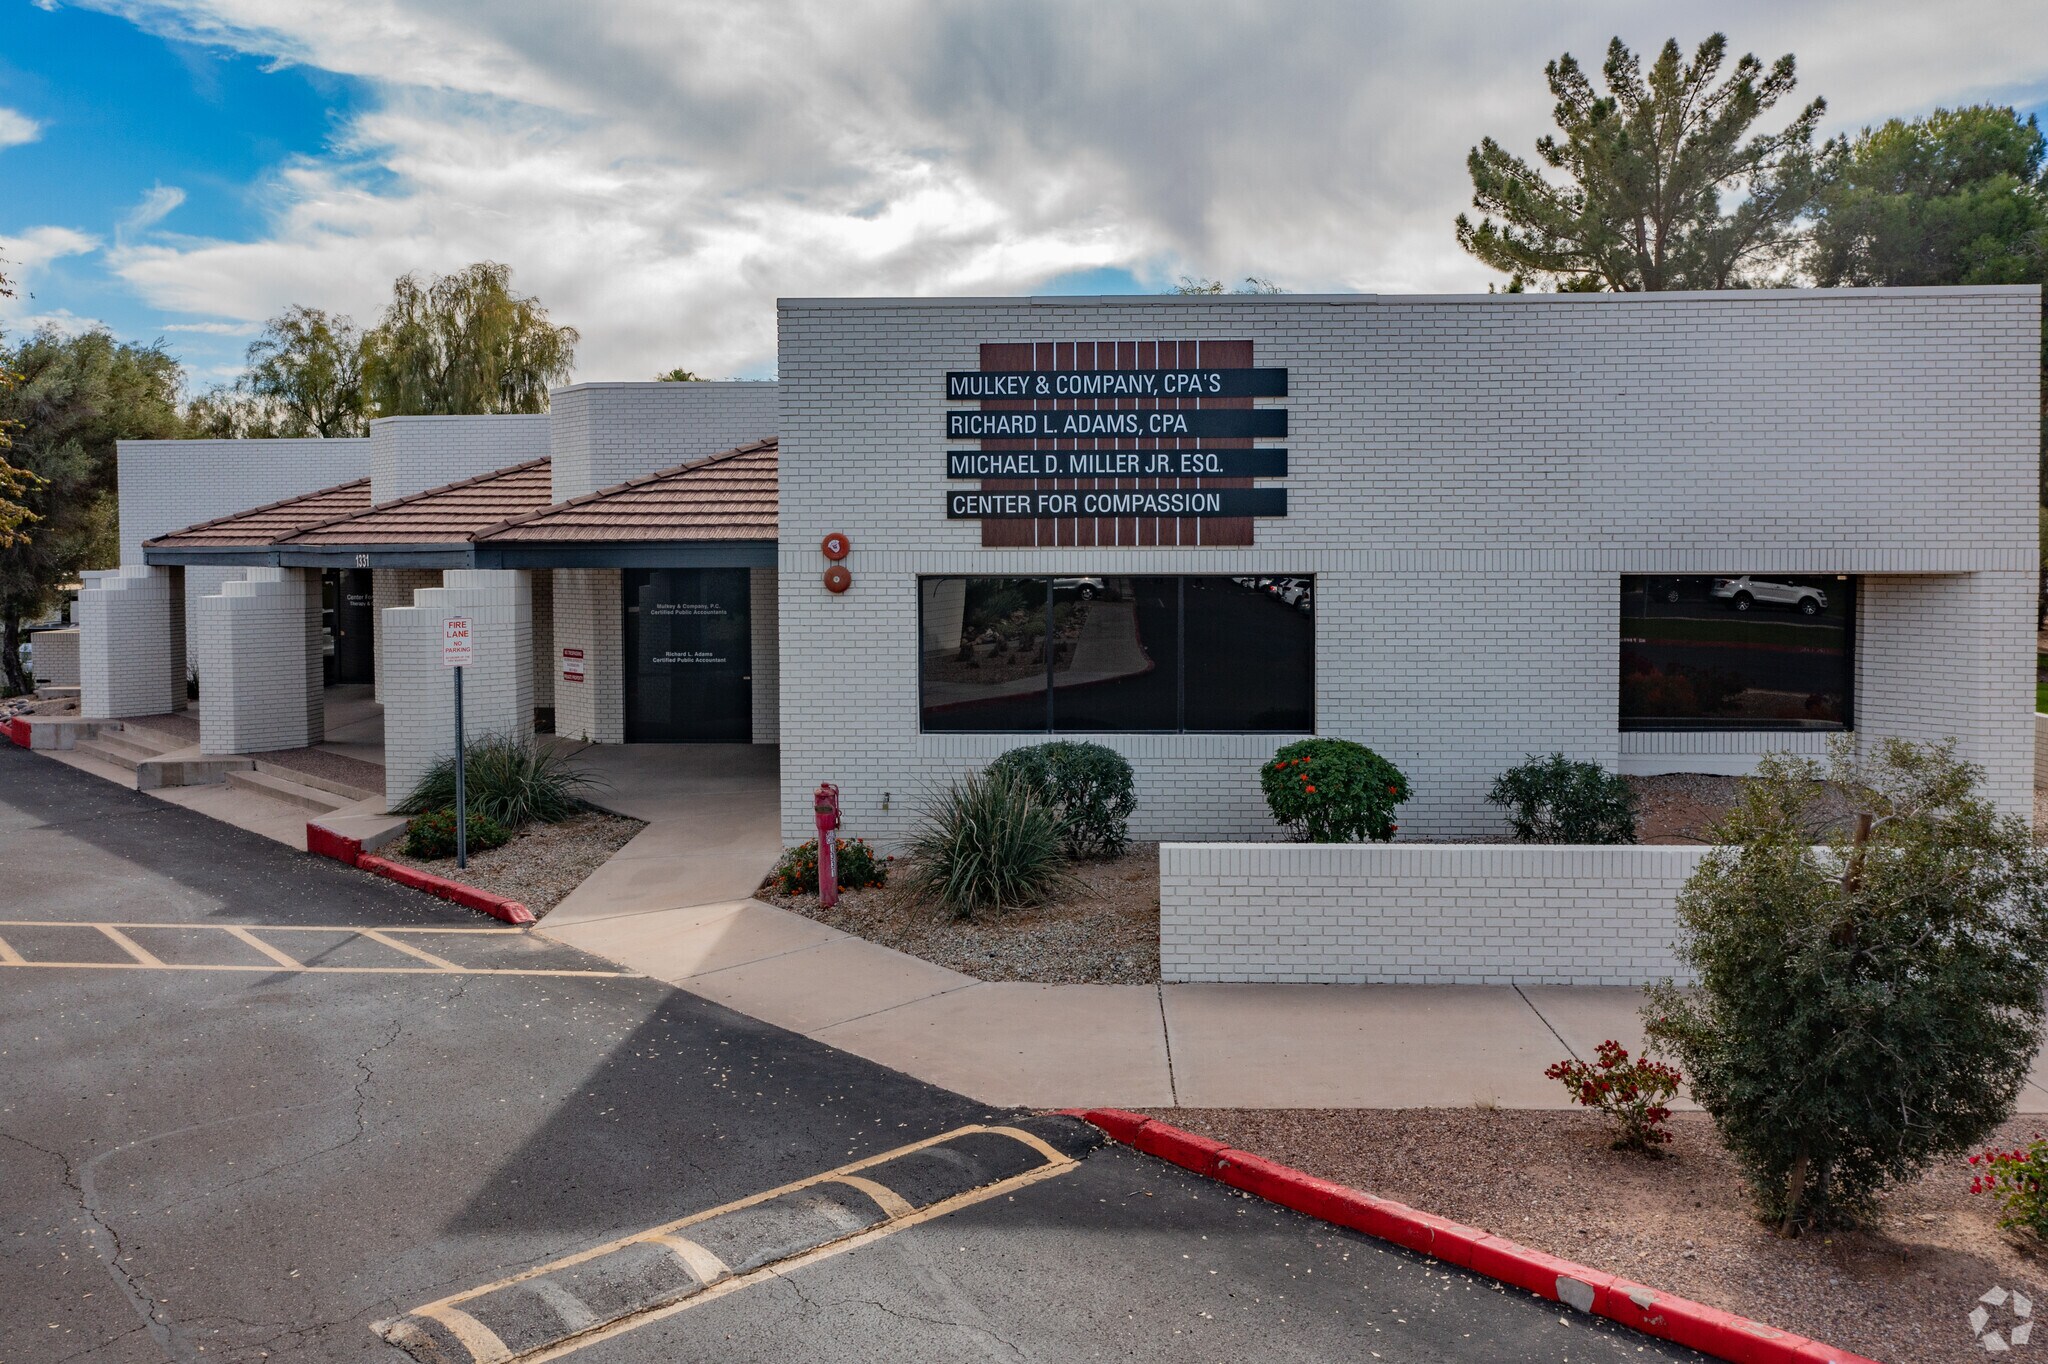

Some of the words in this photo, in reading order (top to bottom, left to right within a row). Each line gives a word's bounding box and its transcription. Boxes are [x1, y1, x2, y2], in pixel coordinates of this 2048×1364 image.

[951, 375, 1030, 395] MULKEY
[1035, 375, 1050, 394] &
[1056, 374, 1158, 396] COMPANY,
[1164, 373, 1221, 394] CPA'S
[951, 415, 1037, 434] RICHARD
[1043, 414, 1058, 433] L.
[1063, 414, 1143, 436] ADAMS,
[1149, 414, 1188, 433] CPA
[951, 455, 1040, 474] MICHAEL
[1045, 454, 1063, 473] D.
[1069, 454, 1140, 473] MILLER
[1144, 454, 1175, 473] JR.
[1180, 453, 1224, 473] ESQ.
[952, 495, 1031, 514] CENTER
[1038, 494, 1077, 513] FOR
[1084, 493, 1220, 513] COMPASSION
[355, 554, 370, 568] 1331
[446, 630, 469, 638] LANE
[448, 621, 467, 629] FIRE
